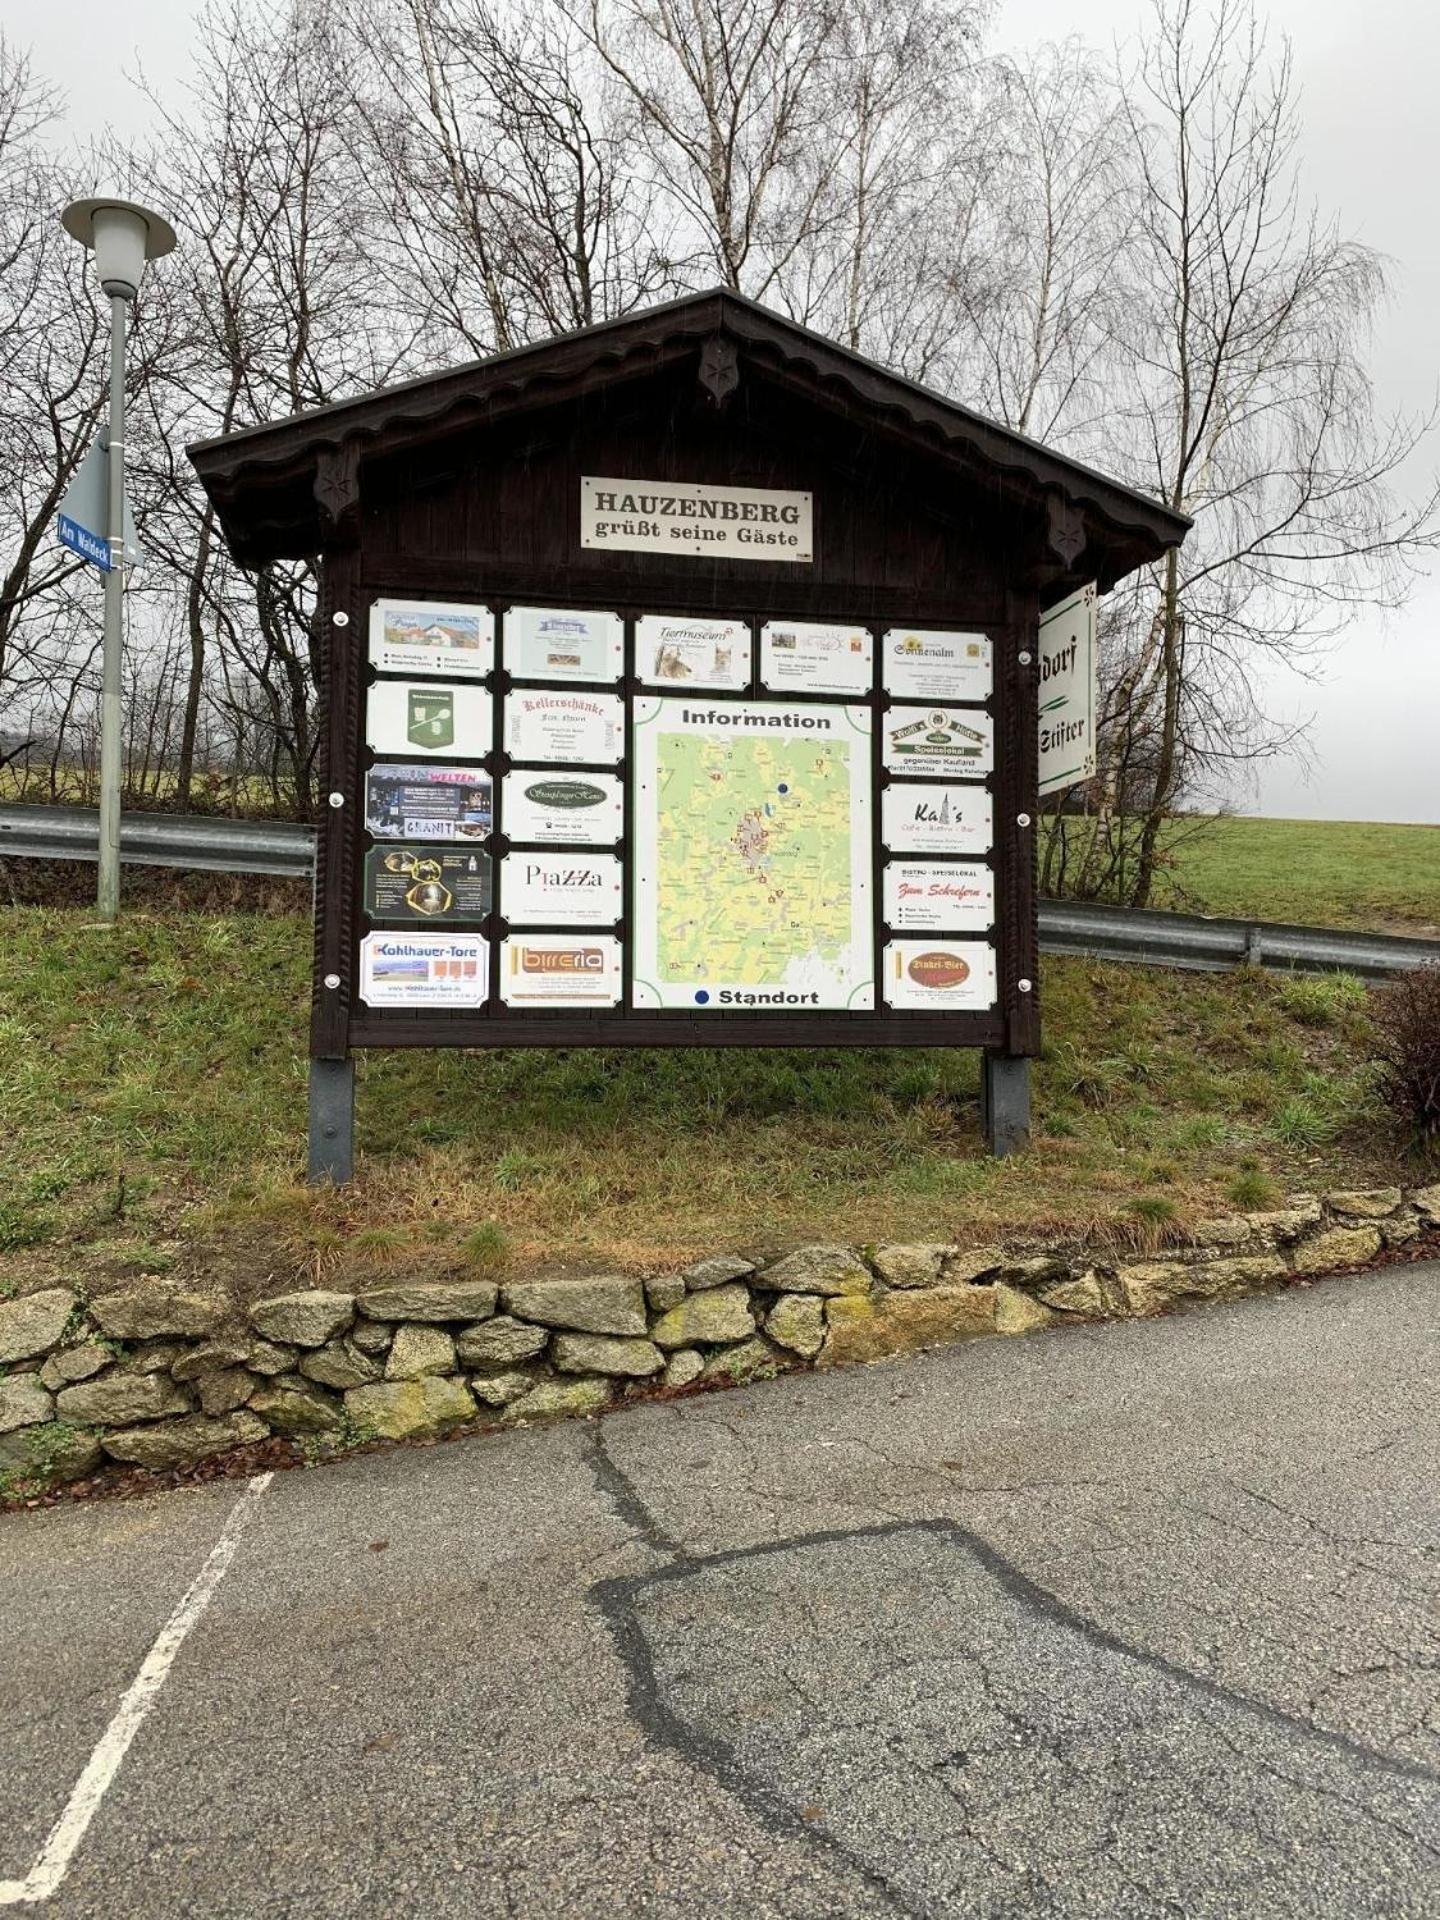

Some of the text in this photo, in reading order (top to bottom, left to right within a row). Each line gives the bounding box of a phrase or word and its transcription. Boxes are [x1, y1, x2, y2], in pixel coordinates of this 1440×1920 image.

[595, 492, 800, 525] HAUZENBERG
[595, 521, 798, 546] grüßt seine Gäste
[77, 529, 108, 564] Waldeck
[682, 709, 832, 729] Information
[378, 944, 477, 957] Kohlhauer-Tore
[719, 990, 819, 1004] Standort
